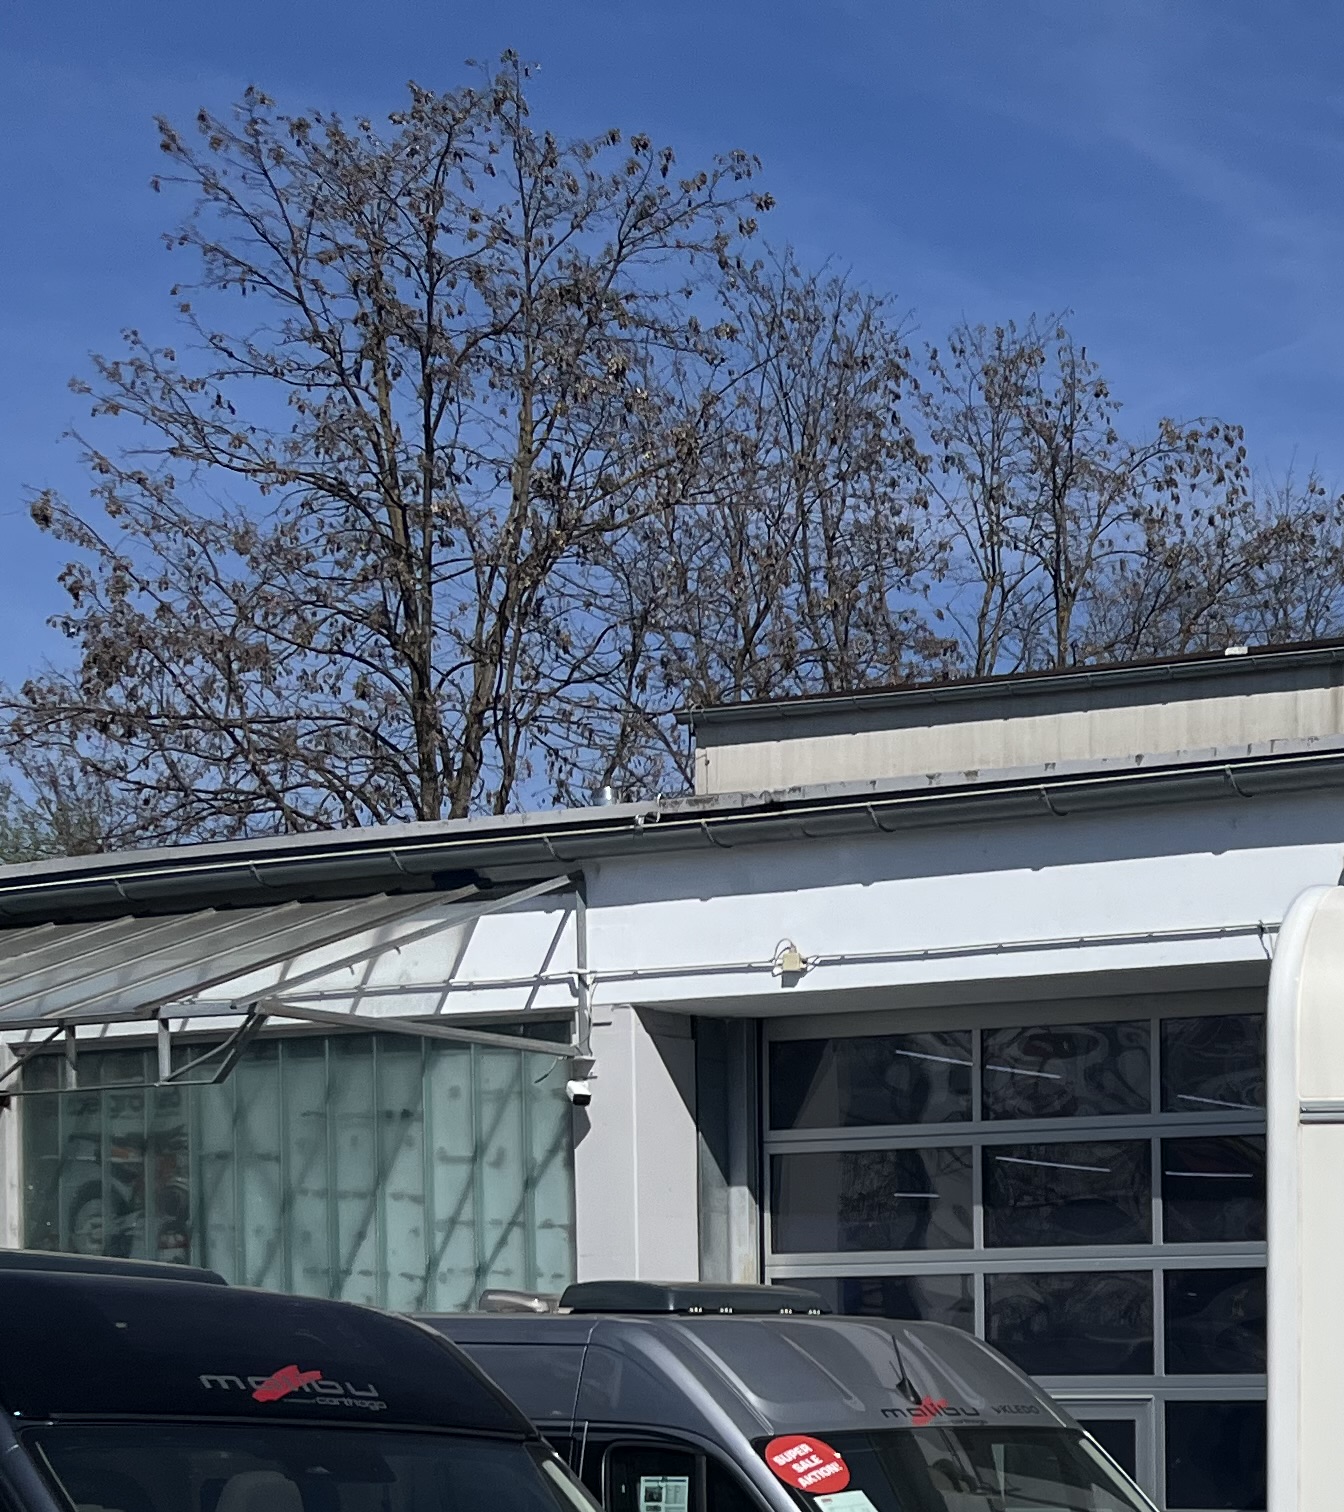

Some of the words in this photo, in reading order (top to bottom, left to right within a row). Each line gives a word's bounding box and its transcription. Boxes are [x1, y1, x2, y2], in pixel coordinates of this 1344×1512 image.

[881, 1402, 980, 1419] malibu
[772, 1443, 814, 1467] SUPER
[791, 1454, 824, 1473] SALE
